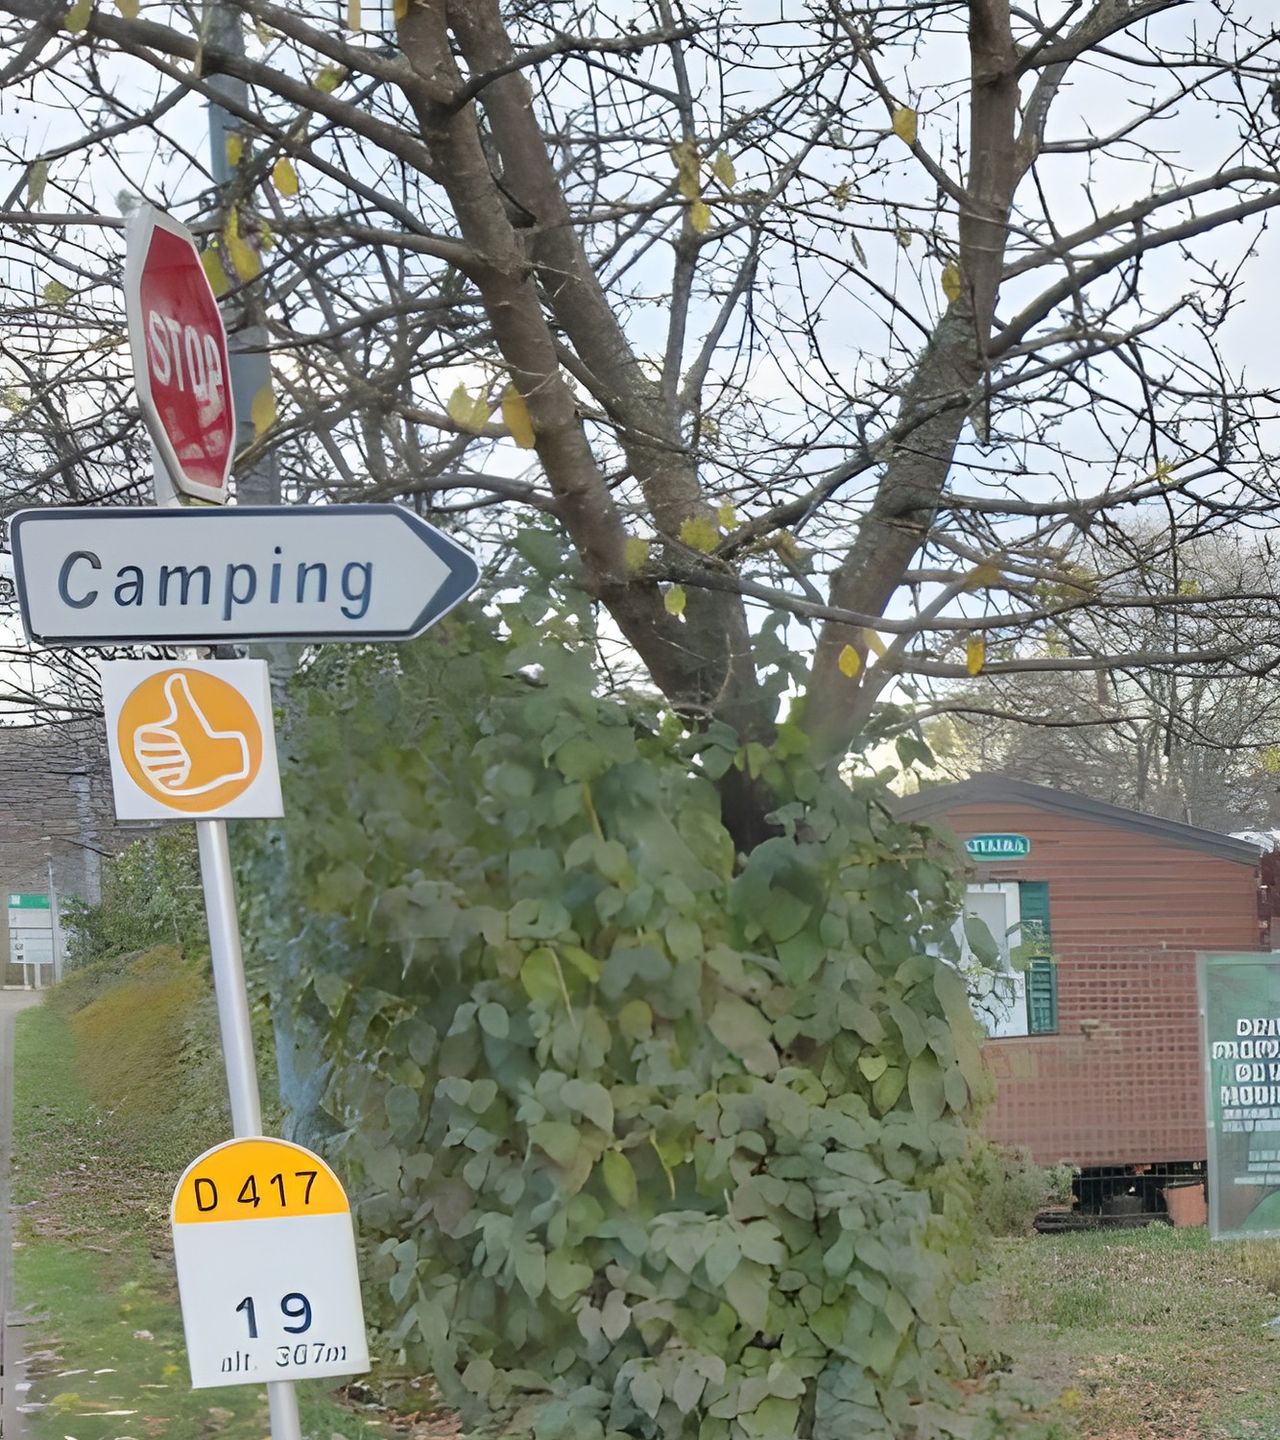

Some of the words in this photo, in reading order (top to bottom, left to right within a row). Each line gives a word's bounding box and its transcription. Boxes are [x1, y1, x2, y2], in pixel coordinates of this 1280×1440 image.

[149, 310, 225, 406] STOP
[58, 545, 373, 621] Camping
[194, 1178, 218, 1212] D
[237, 1171, 318, 1208] 417
[236, 1292, 312, 1338] 19
